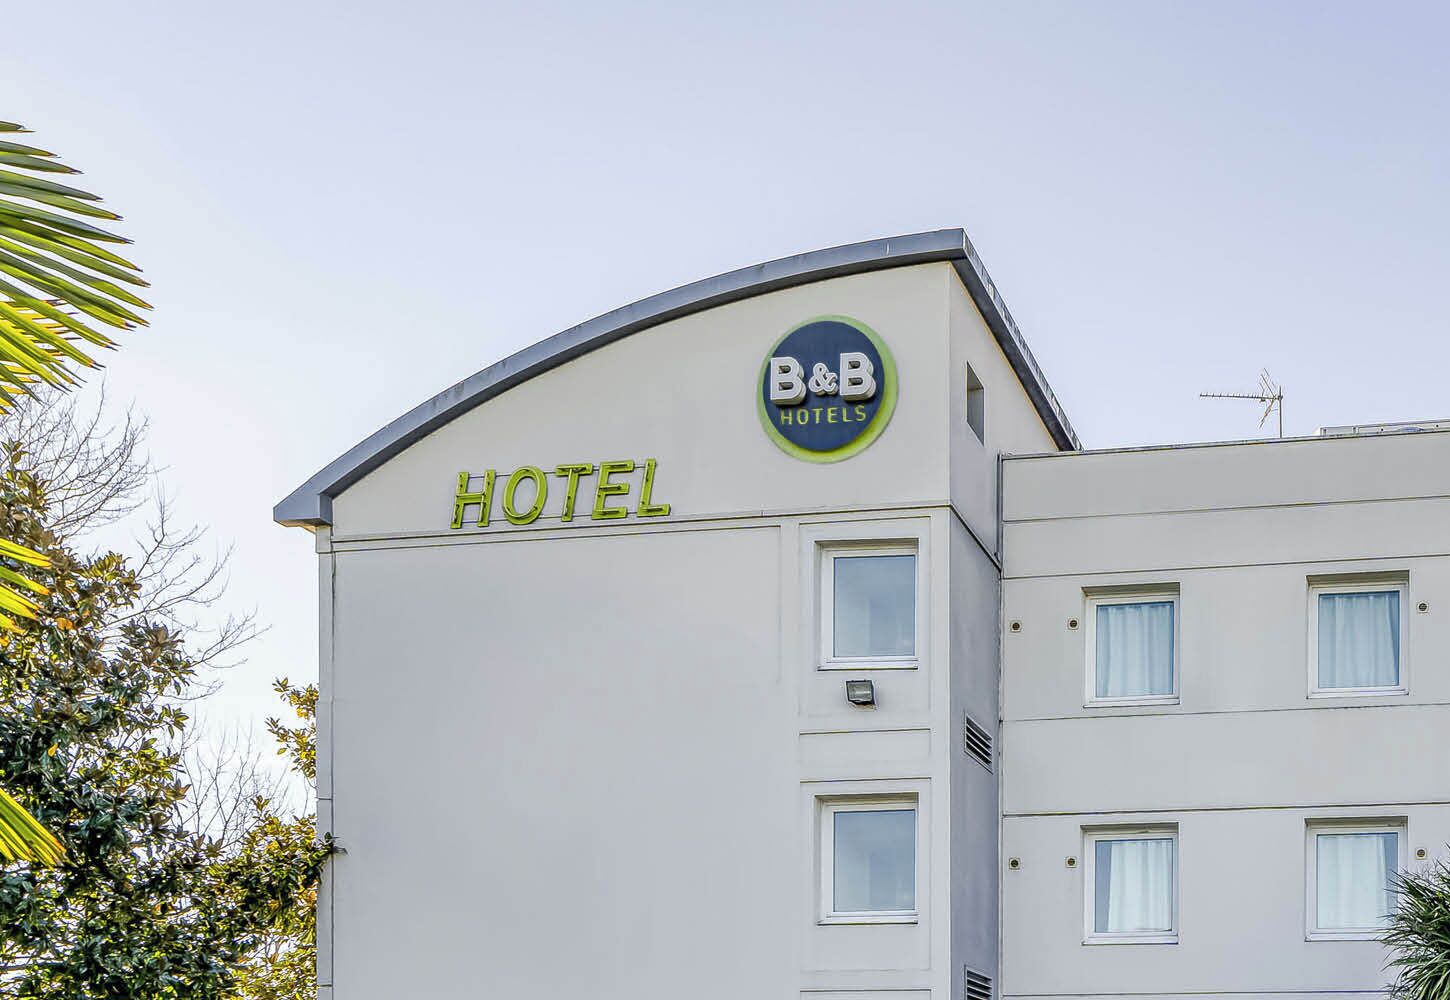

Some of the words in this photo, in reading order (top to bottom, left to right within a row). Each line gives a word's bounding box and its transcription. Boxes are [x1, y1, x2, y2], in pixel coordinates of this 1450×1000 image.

[770, 352, 876, 405] B&B
[780, 405, 867, 426] HOTELS
[450, 458, 671, 529] HOTEL
